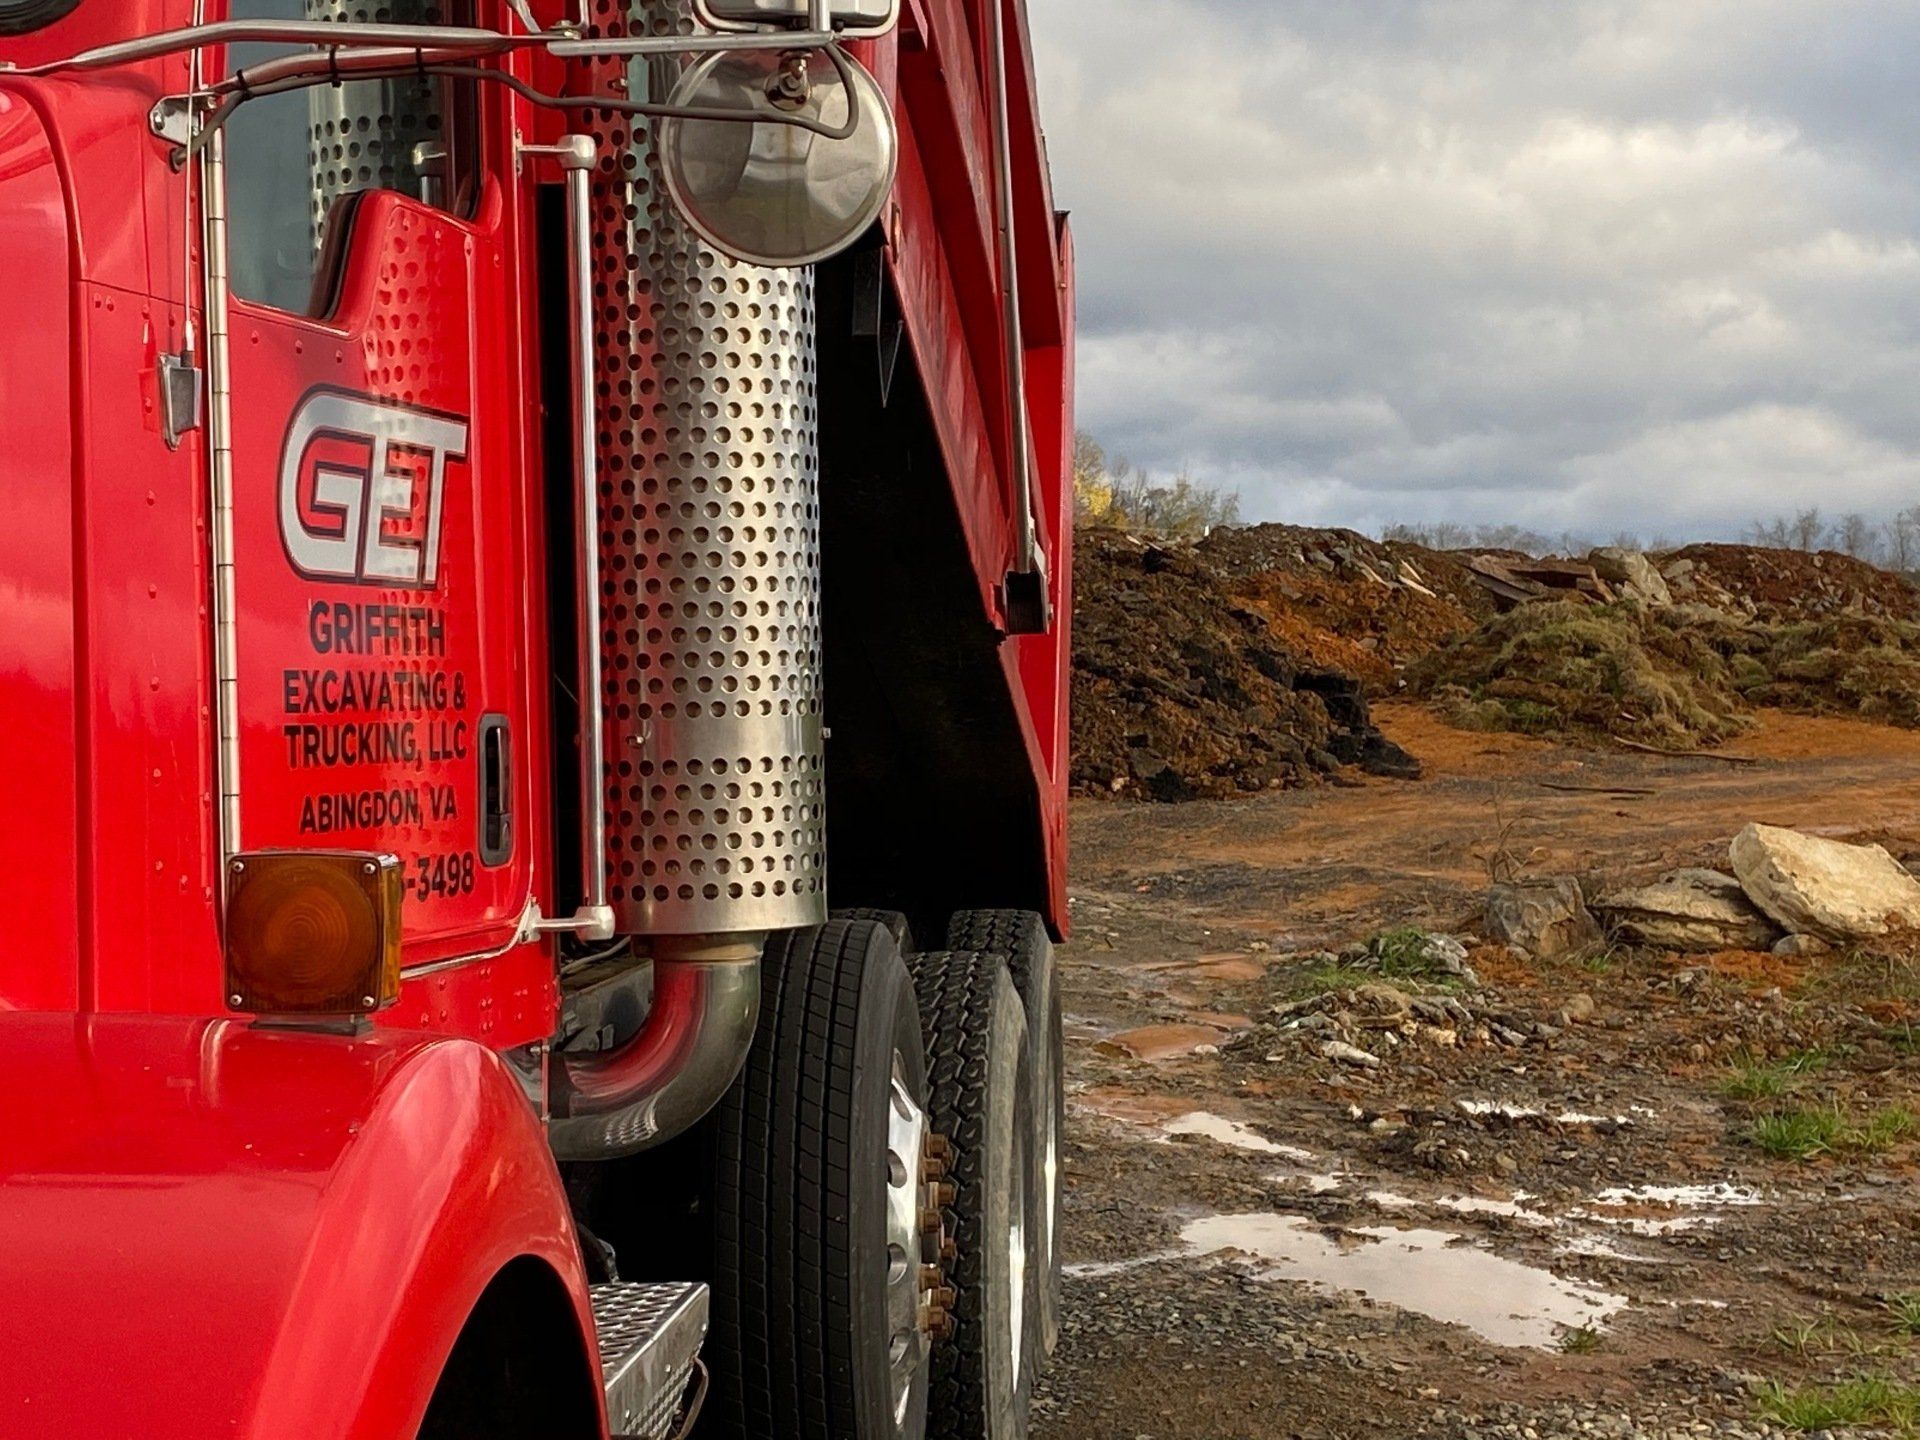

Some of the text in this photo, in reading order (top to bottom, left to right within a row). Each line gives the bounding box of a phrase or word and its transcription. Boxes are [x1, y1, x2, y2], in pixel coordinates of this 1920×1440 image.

[309, 600, 445, 657] GRIFFITH
[284, 670, 466, 714] EXCAVATING &
[284, 719, 467, 771] TRUCKING, LLC
[301, 785, 457, 834] ABINGDON, VA
[400, 851, 475, 902] -3498
